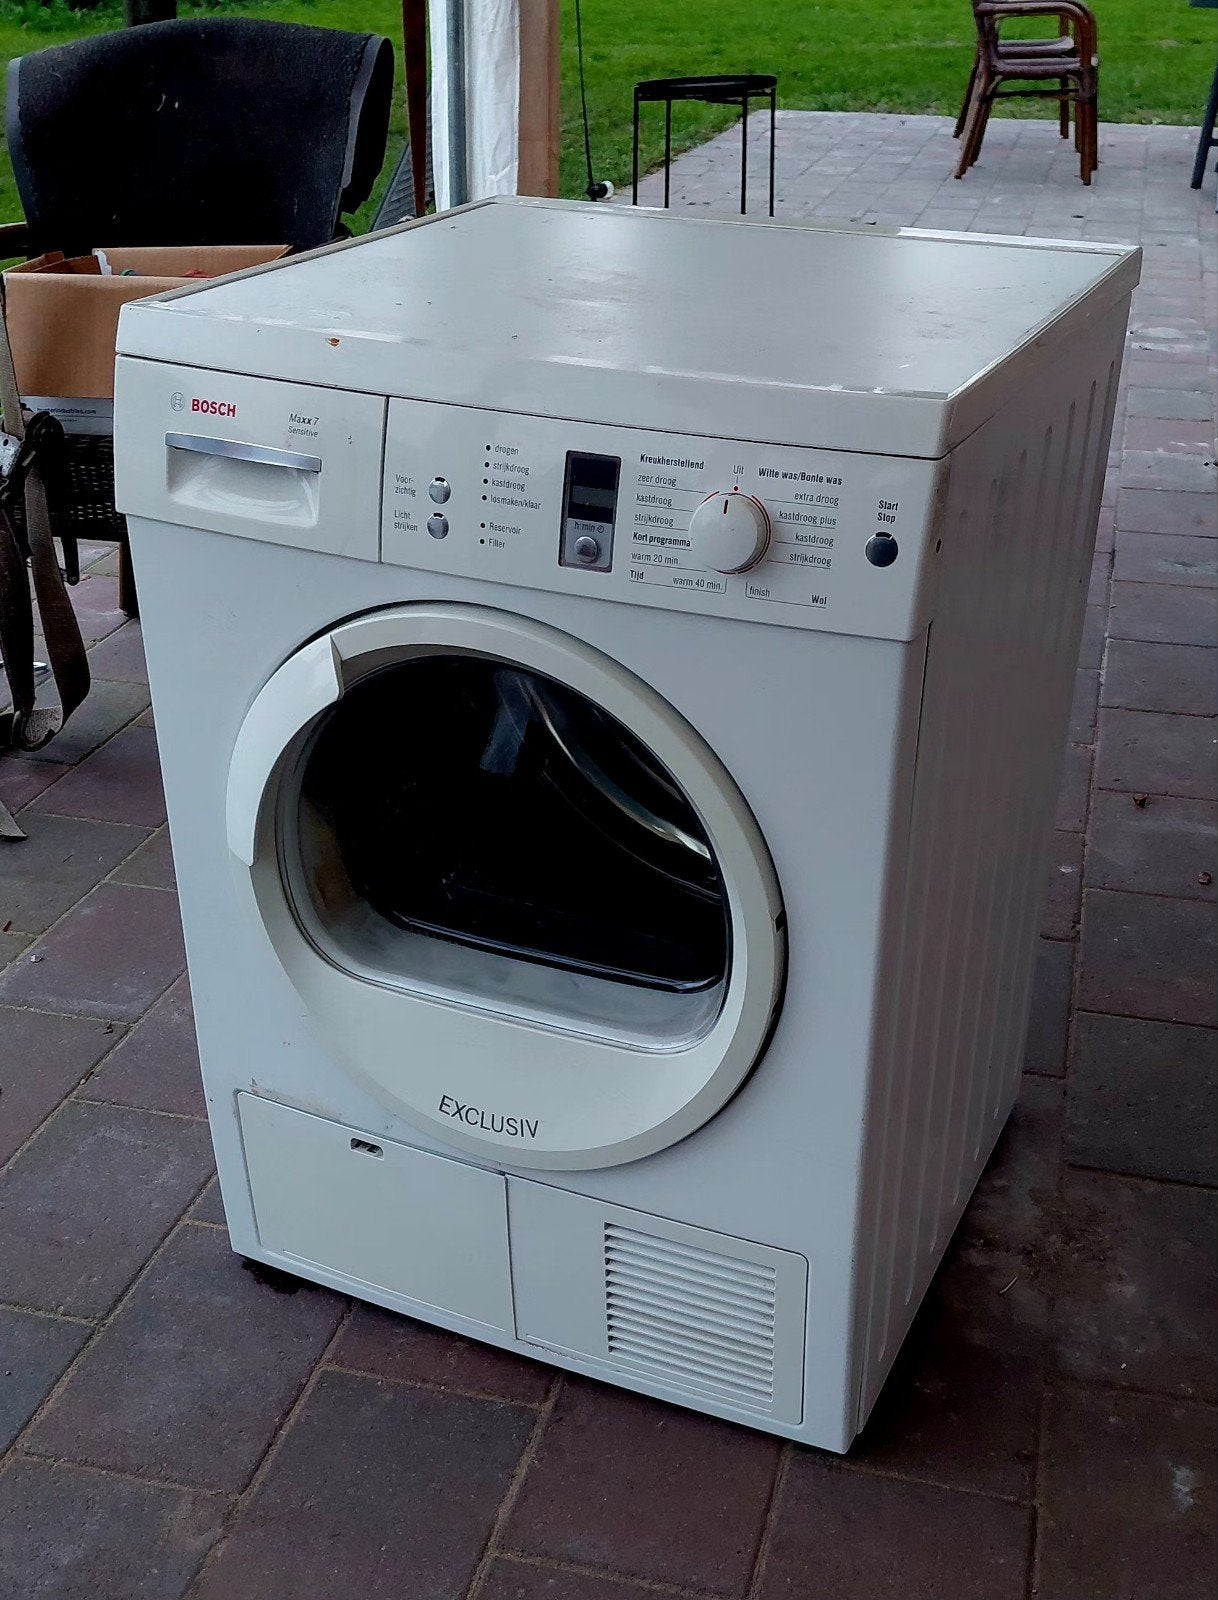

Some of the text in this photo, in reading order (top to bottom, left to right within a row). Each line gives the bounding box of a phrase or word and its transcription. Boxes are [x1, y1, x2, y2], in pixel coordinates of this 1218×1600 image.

[191, 398, 237, 418] BOSCH
[288, 413, 320, 426] Maxx 7
[287, 426, 319, 438] Sensitive
[494, 444, 519, 456] drogen
[493, 461, 530, 475] strijkdroog
[640, 453, 705, 470] Kreukherstellend
[733, 464, 745, 475] Uit
[395, 474, 414, 485] Voor-
[637, 474, 677, 487] zeer droog
[758, 467, 843, 486] Witte was/Bonte was
[491, 478, 526, 491] kastdroog
[394, 486, 417, 498] zichtig
[490, 495, 542, 510] losmaken/klaar
[636, 492, 673, 507] kastdroog
[794, 492, 840, 507] extra droog
[878, 499, 899, 511] Start
[394, 509, 411, 520] Licht
[634, 513, 674, 527] strijkdroog
[778, 510, 837, 526] kastdroog plus
[877, 512, 896, 525] Stop
[393, 522, 418, 533] strijken
[489, 522, 522, 535] Reservoir
[488, 538, 506, 549] Filter
[632, 531, 691, 547] Kort programma
[795, 532, 834, 547] kastdroog
[631, 552, 651, 562] warm
[653, 553, 663, 563] 20
[789, 552, 832, 567] strijkdroog
[629, 569, 644, 581] Tijd
[672, 576, 693, 587] warm
[695, 577, 705, 588] 40
[749, 586, 771, 598] finish
[811, 594, 827, 605] Wol
[438, 1094, 539, 1139] EXCLUSIV
